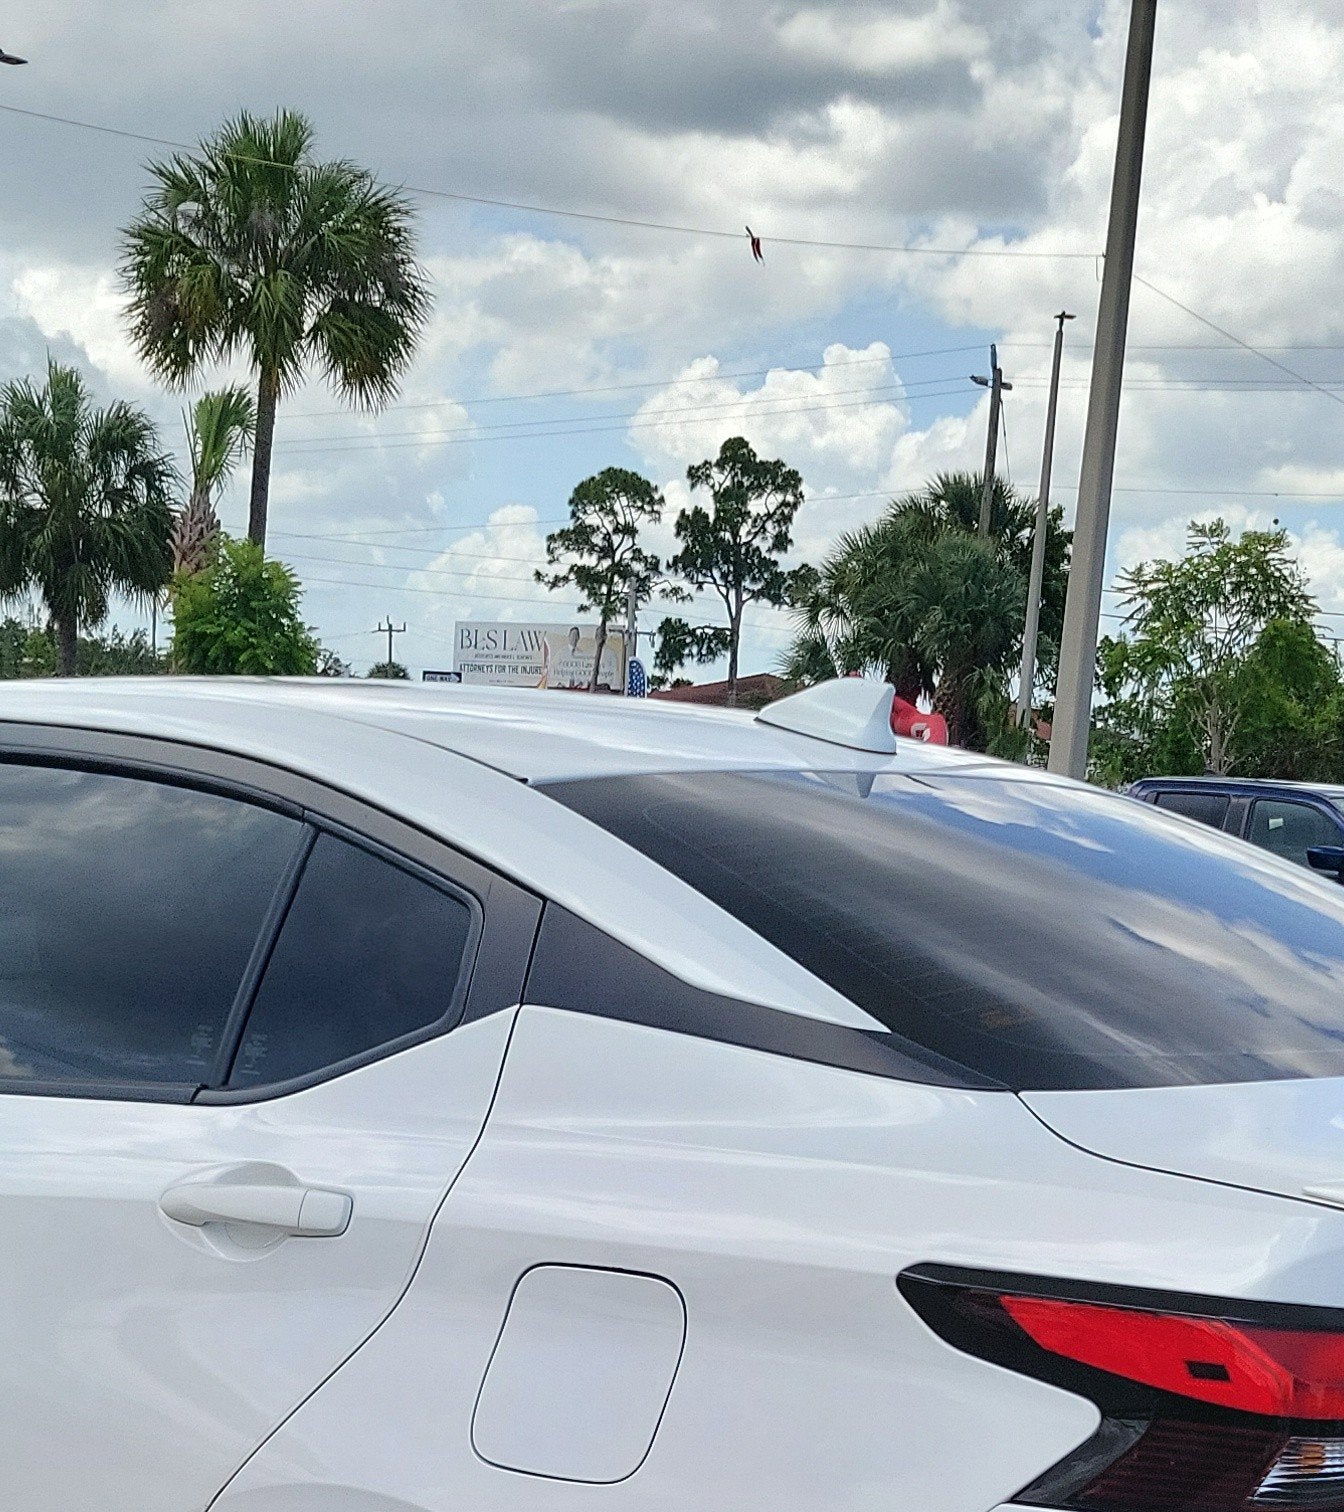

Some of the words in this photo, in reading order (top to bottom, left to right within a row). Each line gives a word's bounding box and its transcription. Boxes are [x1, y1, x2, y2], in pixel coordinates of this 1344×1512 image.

[503, 629, 547, 652] LAW
[459, 662, 493, 674] ATTORNEYS
[495, 664, 507, 674] FOR
[508, 665, 519, 675] THE
[520, 665, 542, 675] INJURE
